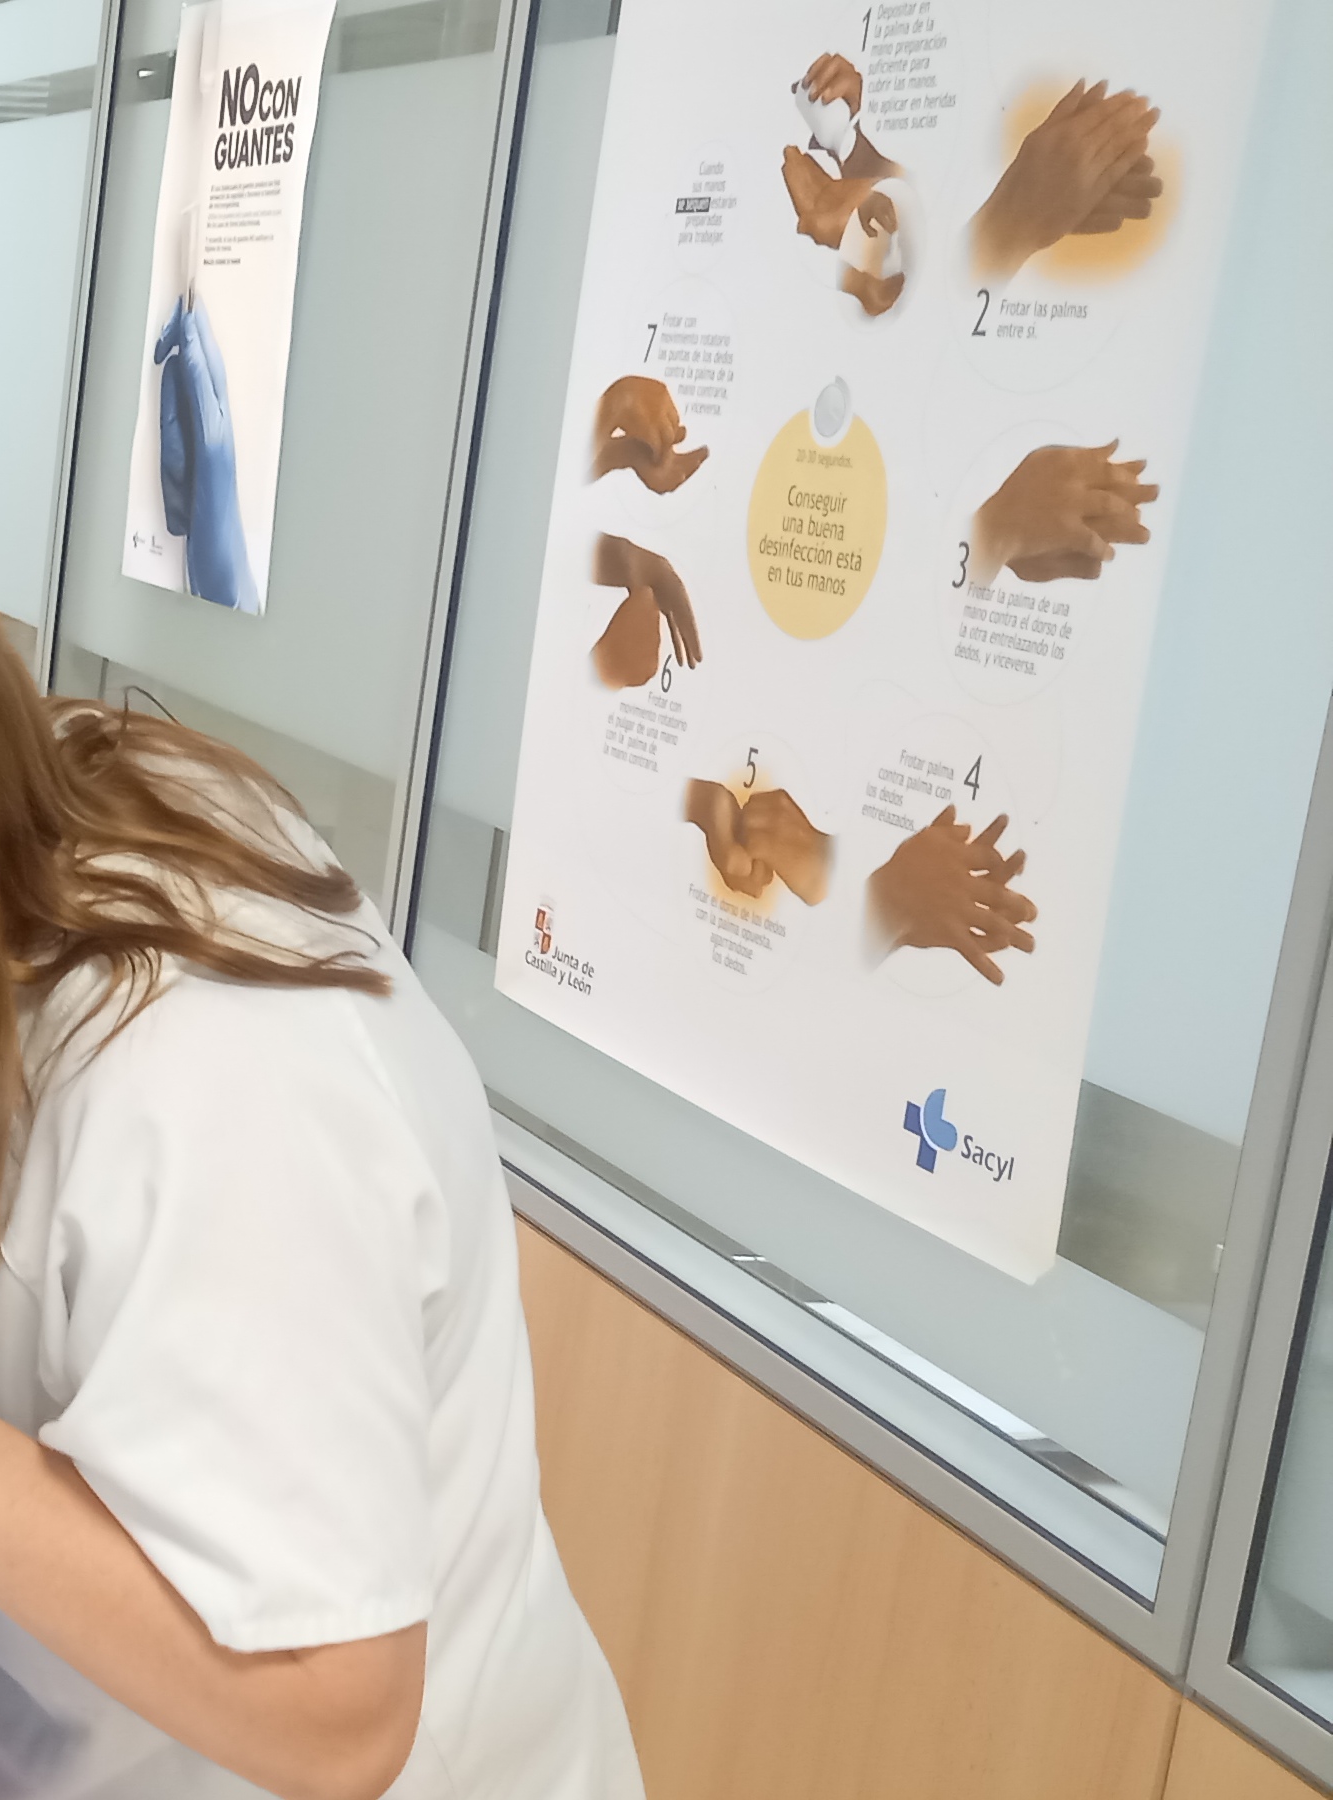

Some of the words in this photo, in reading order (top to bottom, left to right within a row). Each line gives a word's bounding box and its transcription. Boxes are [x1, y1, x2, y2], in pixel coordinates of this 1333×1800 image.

[862, 7, 871, 52] 1
[218, 63, 260, 129] NO
[258, 76, 302, 122] CON
[214, 122, 295, 171] GUANTES
[971, 288, 989, 336] 2
[1000, 299, 1031, 316] Frotar
[1034, 301, 1047, 318] las
[1050, 301, 1088, 321] palmas
[997, 324, 1023, 338] entre
[643, 324, 657, 363] 7
[787, 485, 847, 517] Conseguir
[783, 516, 803, 534] una
[807, 514, 845, 541] buena
[759, 534, 833, 566] desinfección
[837, 548, 862, 572] está
[952, 541, 969, 588] 3
[767, 565, 781, 582] en
[786, 566, 803, 588] tus
[807, 573, 845, 596] manos
[967, 582, 995, 602] Frotar
[997, 588, 1005, 604] la
[1007, 592, 1035, 610] palma
[1037, 596, 1051, 613] de
[1053, 603, 1069, 617] una
[959, 622, 967, 638] la
[969, 626, 987, 642] otra
[989, 632, 1049, 656] entrelazando
[1051, 641, 1065, 660] los
[963, 605, 987, 622] mano
[989, 610, 1017, 628] contra
[1020, 614, 1029, 630] el
[1031, 616, 1057, 636] dorso
[1059, 622, 1072, 640] de
[661, 654, 673, 693] 6
[984, 652, 991, 668] y
[743, 747, 759, 788] 5
[900, 749, 925, 771] Frotar
[927, 761, 954, 780] palma
[963, 755, 982, 800] 4
[879, 768, 905, 786] contra
[906, 776, 933, 796] palma
[935, 786, 951, 800] con
[879, 786, 903, 806] dedos
[525, 950, 557, 978] Castilla
[558, 970, 566, 986] y
[567, 971, 591, 996] León
[552, 946, 579, 970] Junta
[581, 961, 595, 978] de
[961, 1134, 1015, 1182] Sacyl
